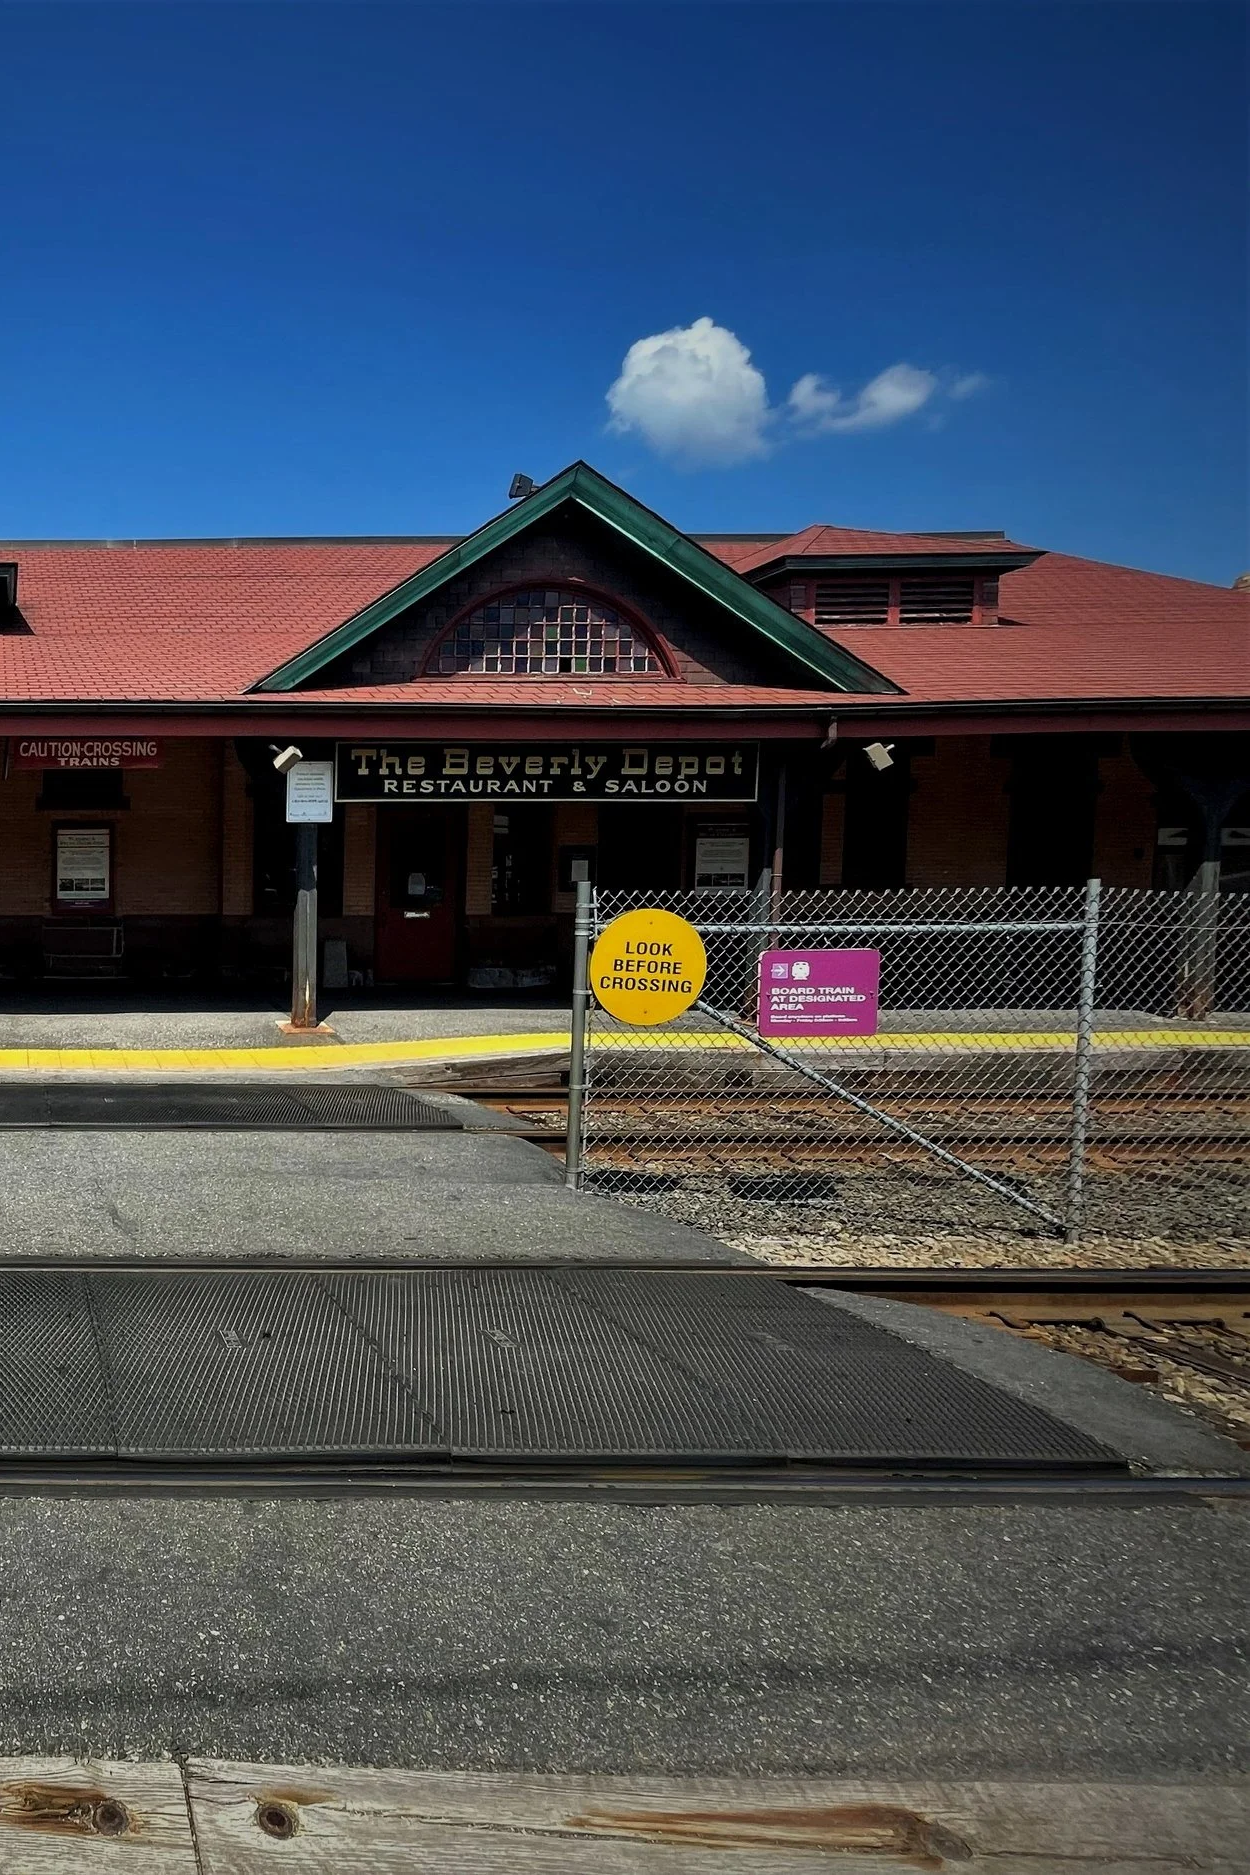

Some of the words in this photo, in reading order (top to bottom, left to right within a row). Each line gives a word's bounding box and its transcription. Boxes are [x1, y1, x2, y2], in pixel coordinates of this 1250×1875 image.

[57, 757, 120, 766] TRAINS
[351, 749, 425, 775] The
[442, 749, 607, 779] Beverly
[621, 749, 742, 779] Depot
[384, 780, 553, 793] RESTAURANT
[572, 781, 586, 792] &
[604, 780, 707, 793] SALOON
[625, 941, 673, 956] LOOK
[613, 959, 682, 975] BEFORE
[600, 976, 692, 993] CROSSING
[771, 987, 815, 995] BOARD
[770, 995, 787, 1003] AT
[789, 994, 866, 1002] DESIGNATED
[770, 1003, 804, 1011] AREA
